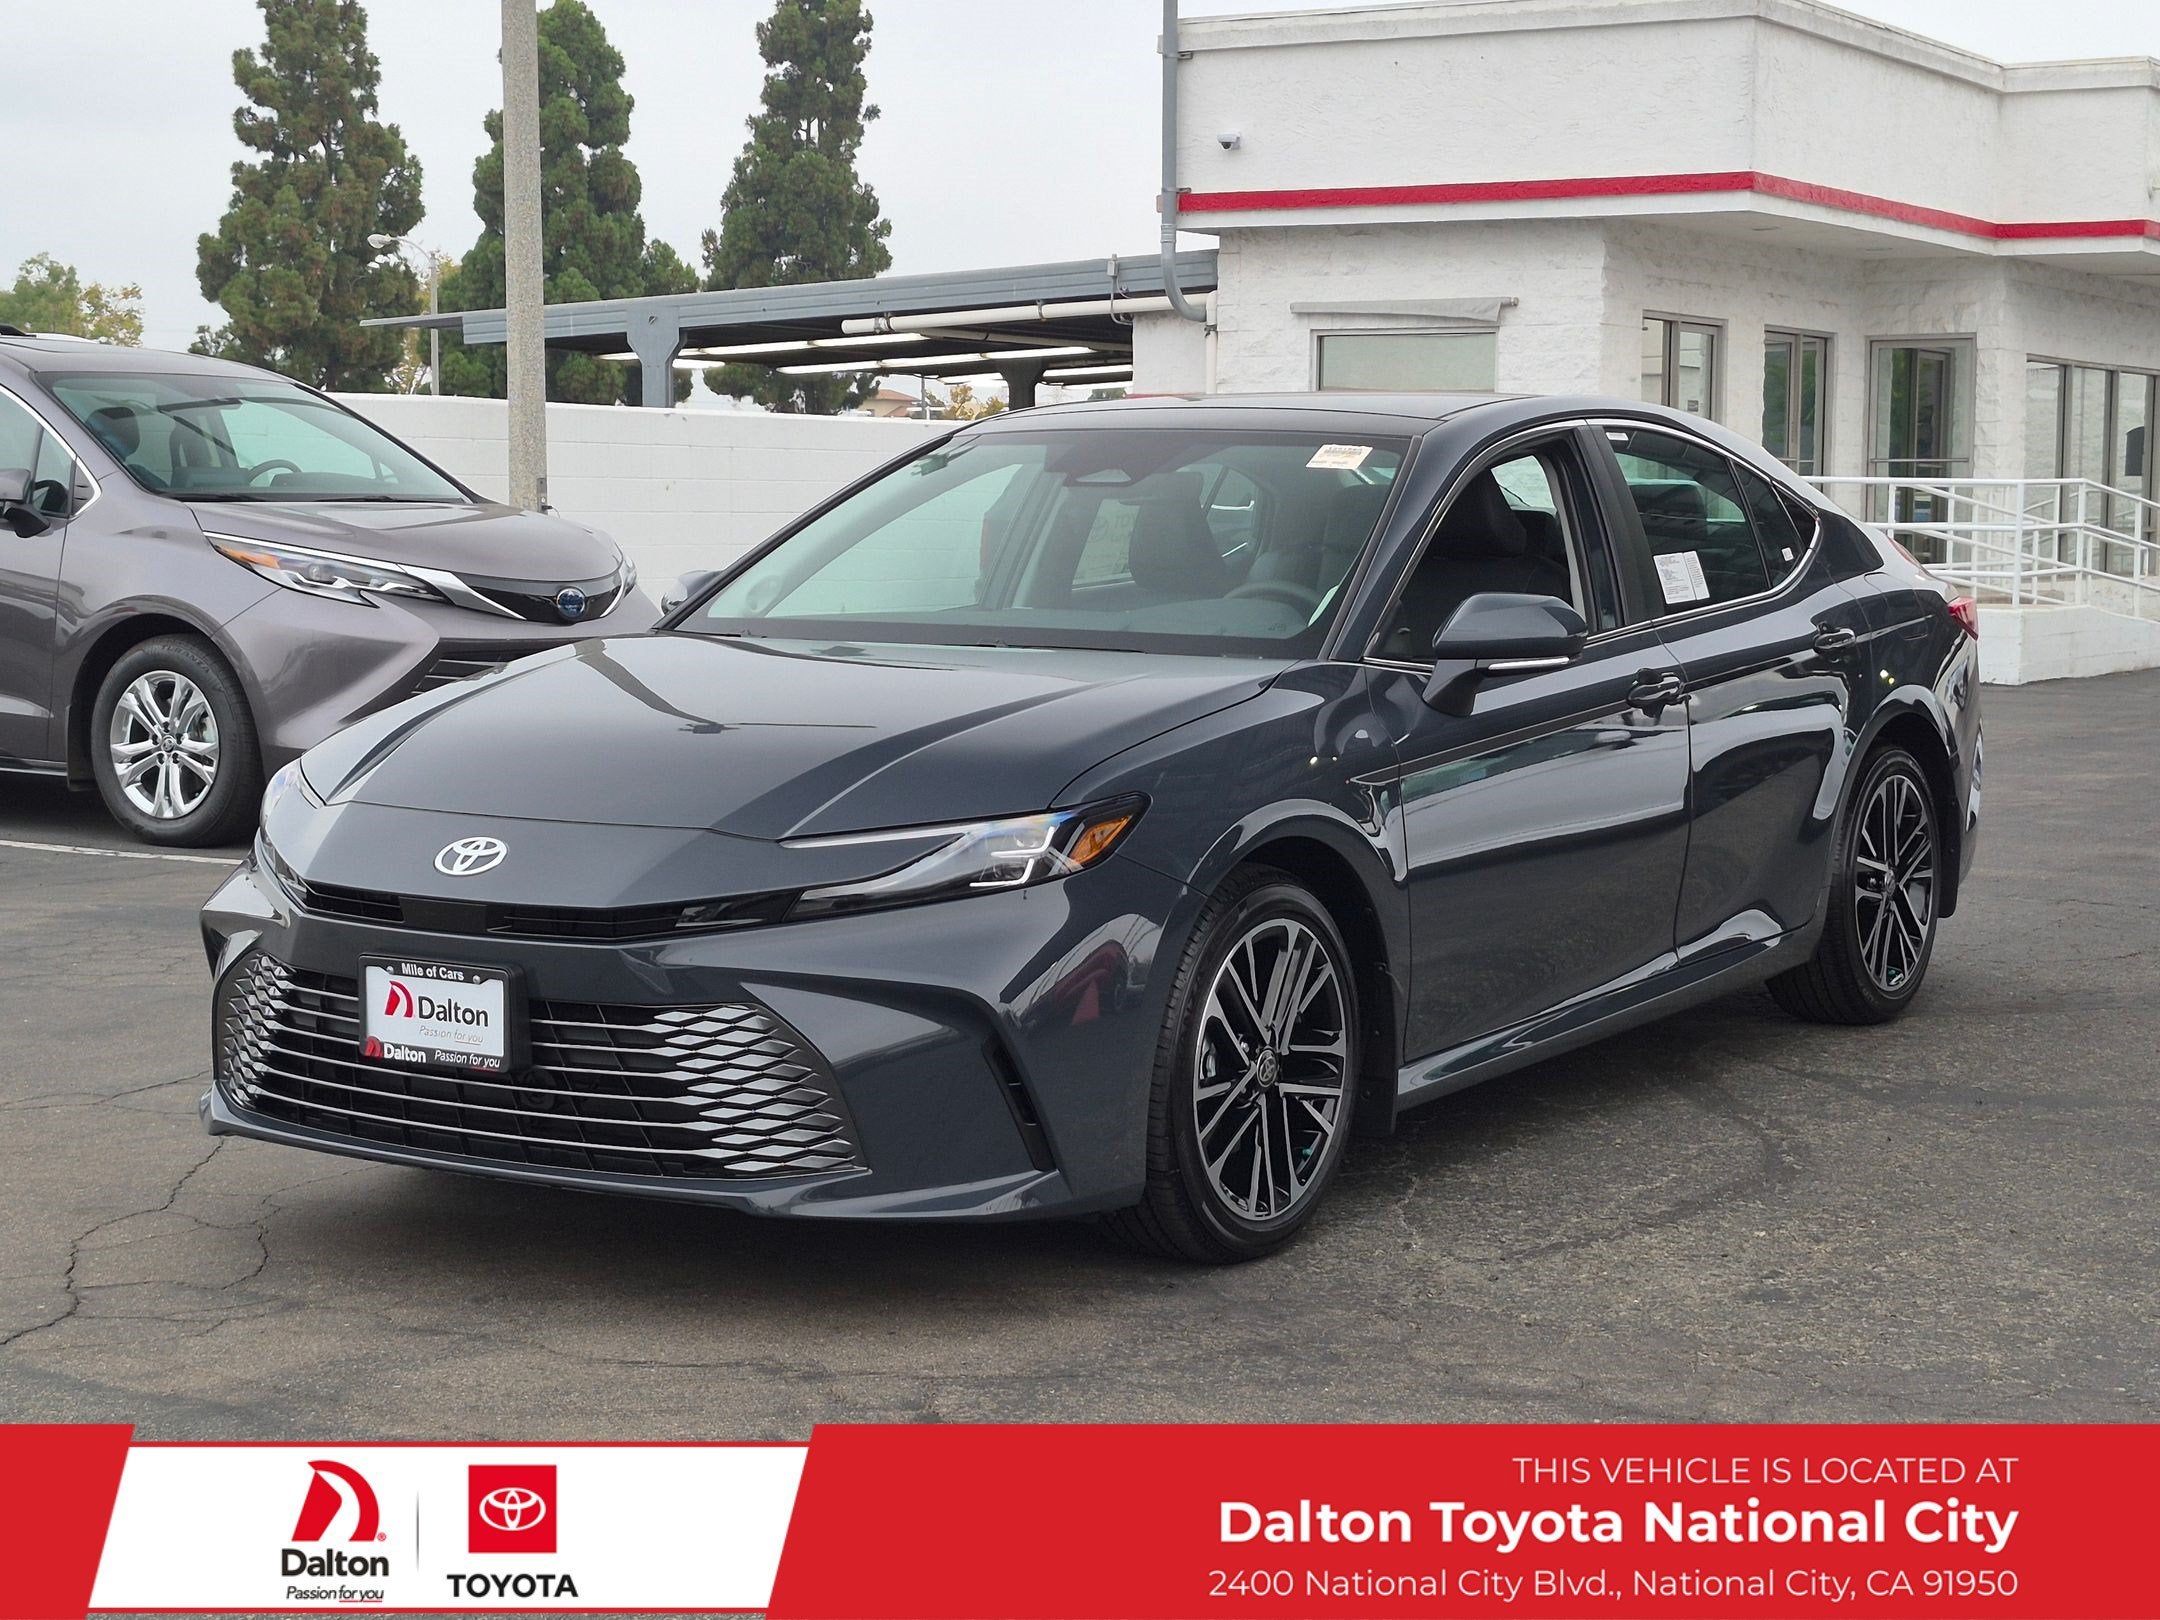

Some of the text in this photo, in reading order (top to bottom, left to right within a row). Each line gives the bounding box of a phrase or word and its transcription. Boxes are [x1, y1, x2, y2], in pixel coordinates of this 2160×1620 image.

[401, 962, 465, 981] Mile of Cars
[417, 995, 489, 1027] Dalton
[419, 1025, 484, 1044] Passion for you
[383, 1043, 427, 1063] Dalton
[434, 1049, 501, 1069] Passion for you
